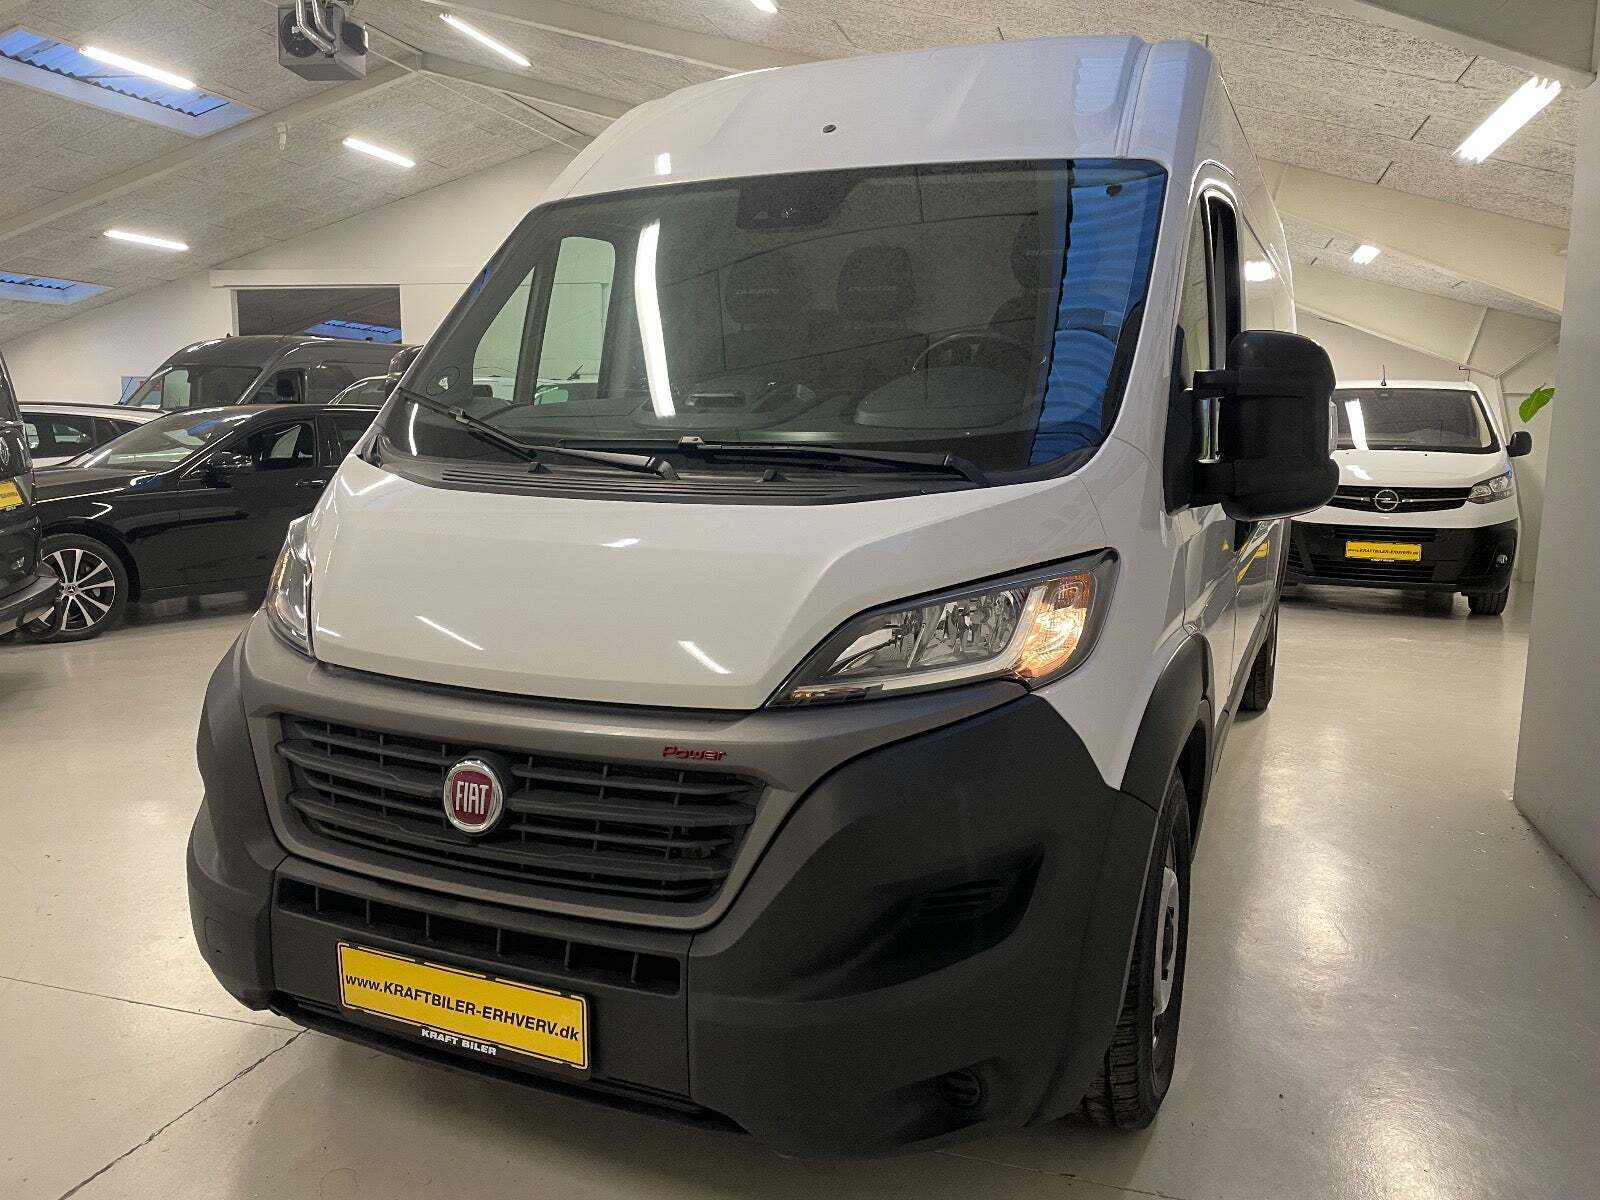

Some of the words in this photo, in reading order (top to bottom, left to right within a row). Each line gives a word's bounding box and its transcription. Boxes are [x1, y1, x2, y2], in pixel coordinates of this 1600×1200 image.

[662, 745, 727, 761] Power
[455, 780, 490, 815] FIAT
[345, 974, 580, 1042] www.KRAFTBILER-ERHVERV.dk
[421, 1028, 458, 1045] KRAFT
[461, 1039, 497, 1056] BILER
